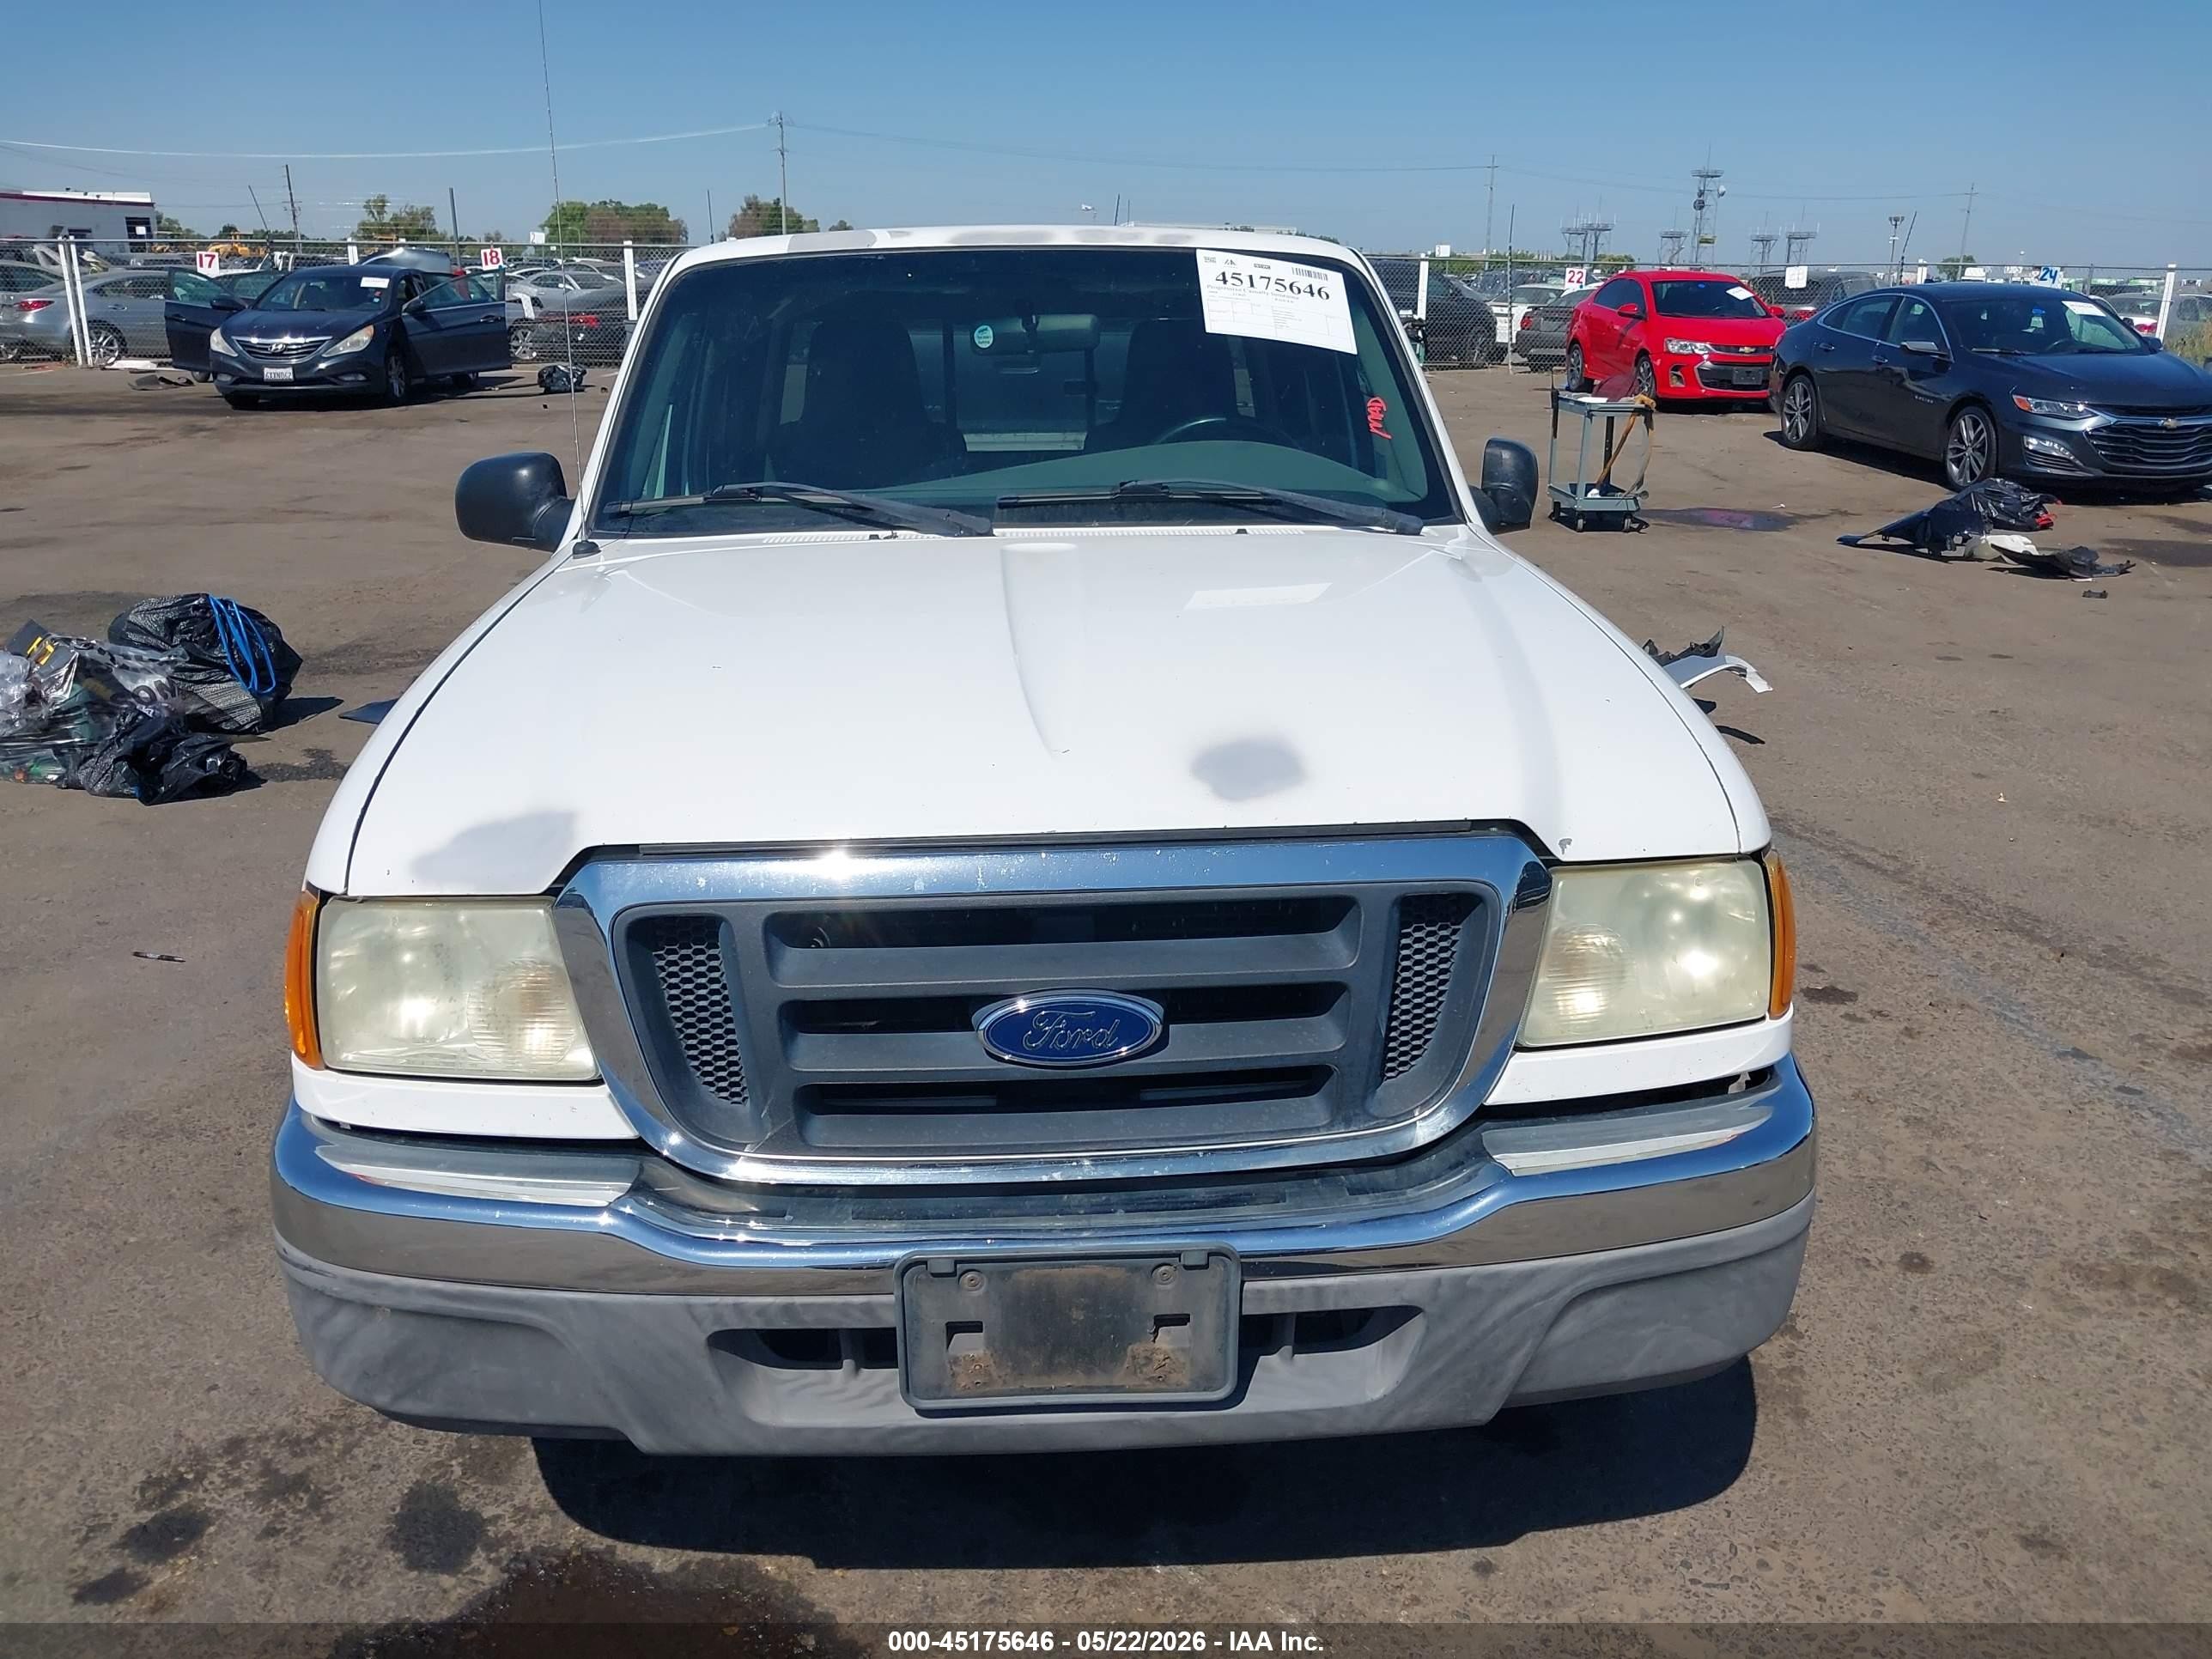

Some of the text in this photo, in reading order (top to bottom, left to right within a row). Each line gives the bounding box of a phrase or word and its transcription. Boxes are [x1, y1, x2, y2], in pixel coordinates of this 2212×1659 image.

[198, 253, 216, 269] 17
[483, 250, 500, 265] 18
[1567, 270, 1583, 284] 22
[2039, 267, 2058, 284] 24
[1215, 271, 1330, 301] 45175646
[1023, 1009, 1121, 1051] Ford
